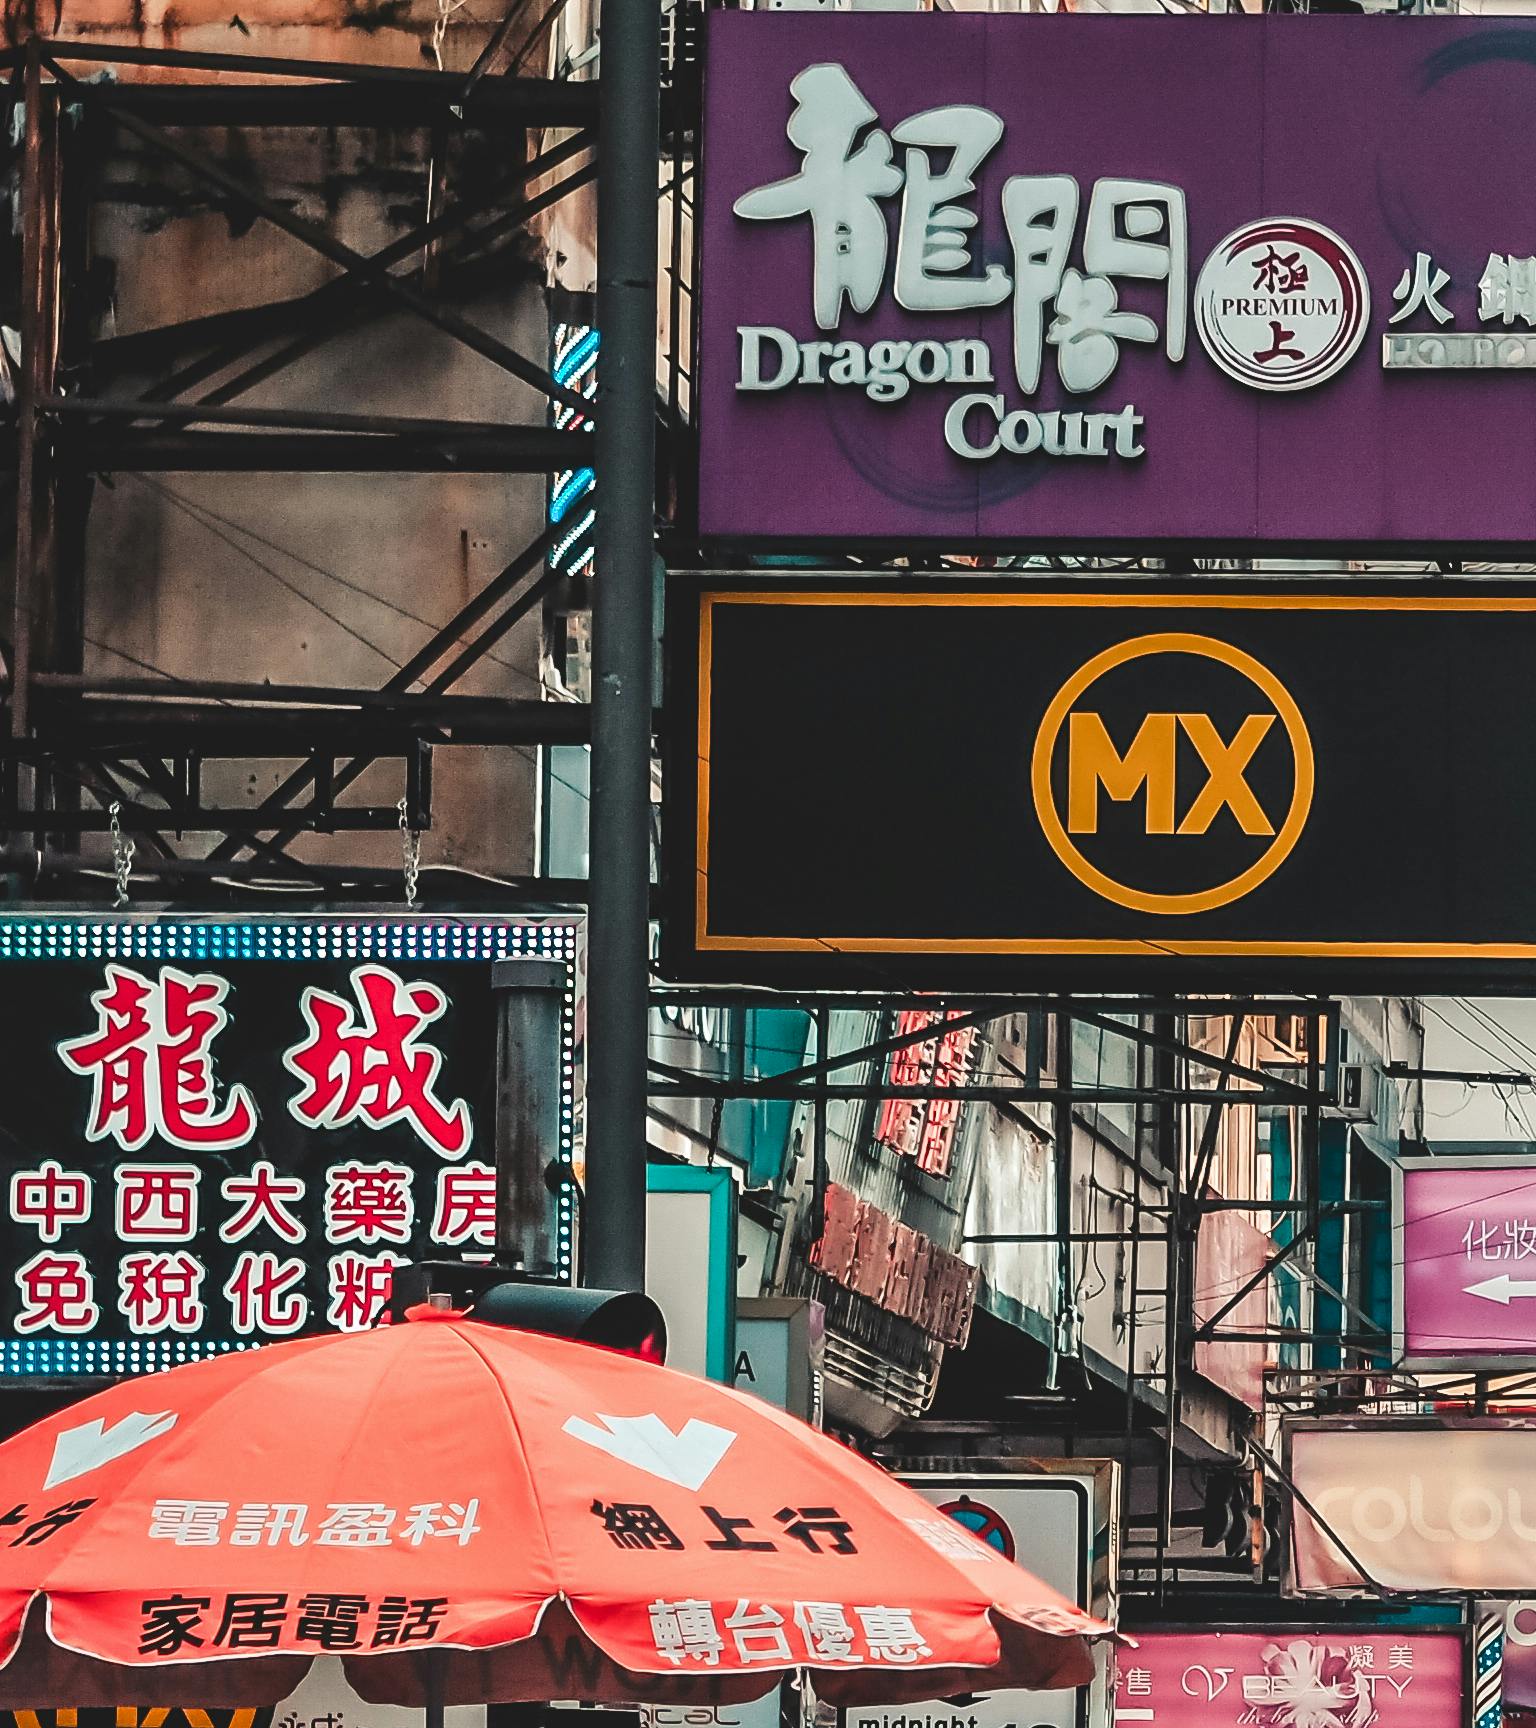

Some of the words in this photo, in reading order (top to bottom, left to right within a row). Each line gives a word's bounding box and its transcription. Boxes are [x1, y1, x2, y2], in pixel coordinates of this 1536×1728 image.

[1221, 296, 1339, 318] PREMIUM
[736, 326, 994, 402] Dragon
[945, 395, 1146, 460] Court
[1068, 712, 1277, 836] MX
[56, 963, 474, 1160] 龍城
[148, 1498, 481, 1548] 電訊盈科
[590, 1498, 859, 1556] 網上行
[138, 1593, 450, 1656] 家居電話
[648, 1598, 935, 1666] 轉台優惠
